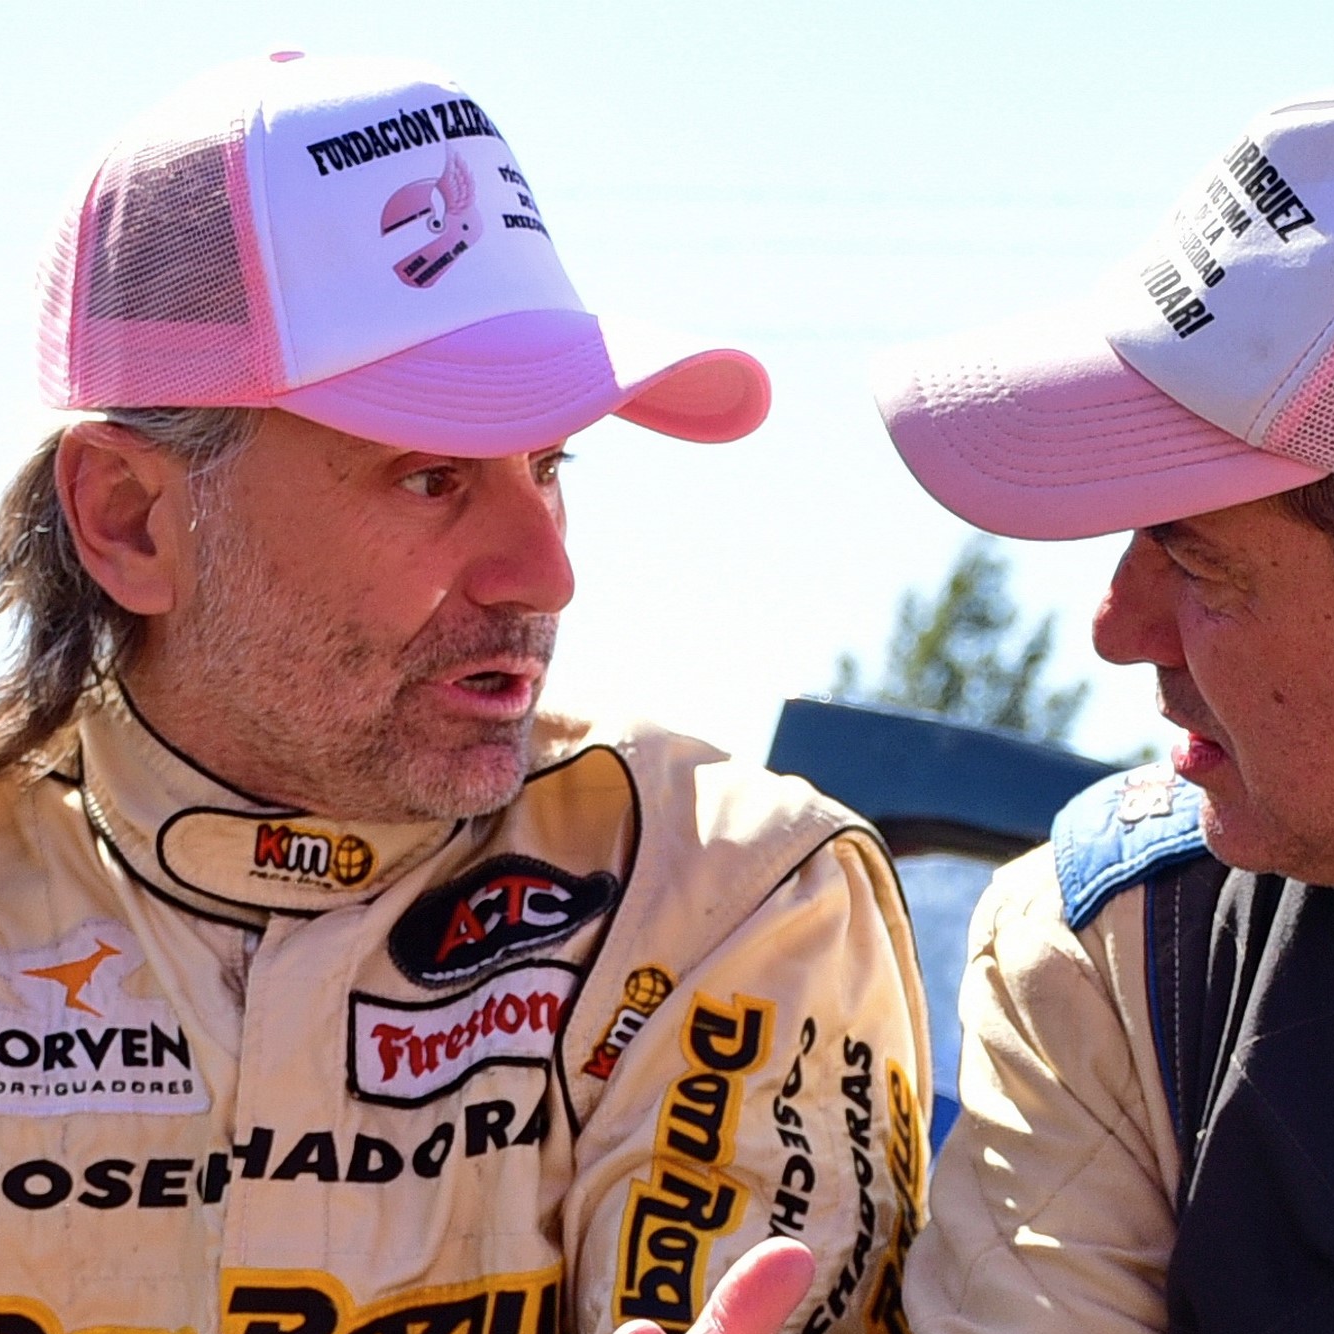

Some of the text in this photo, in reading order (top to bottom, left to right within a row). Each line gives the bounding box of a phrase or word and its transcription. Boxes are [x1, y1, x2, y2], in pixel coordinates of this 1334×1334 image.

[306, 108, 441, 176] FUNDACIÓN
[1202, 218, 1225, 246] LA
[1206, 174, 1253, 239] VICTIMA
[371, 990, 565, 1082] Fireston
[621, 1008, 763, 1334] Don Roq
